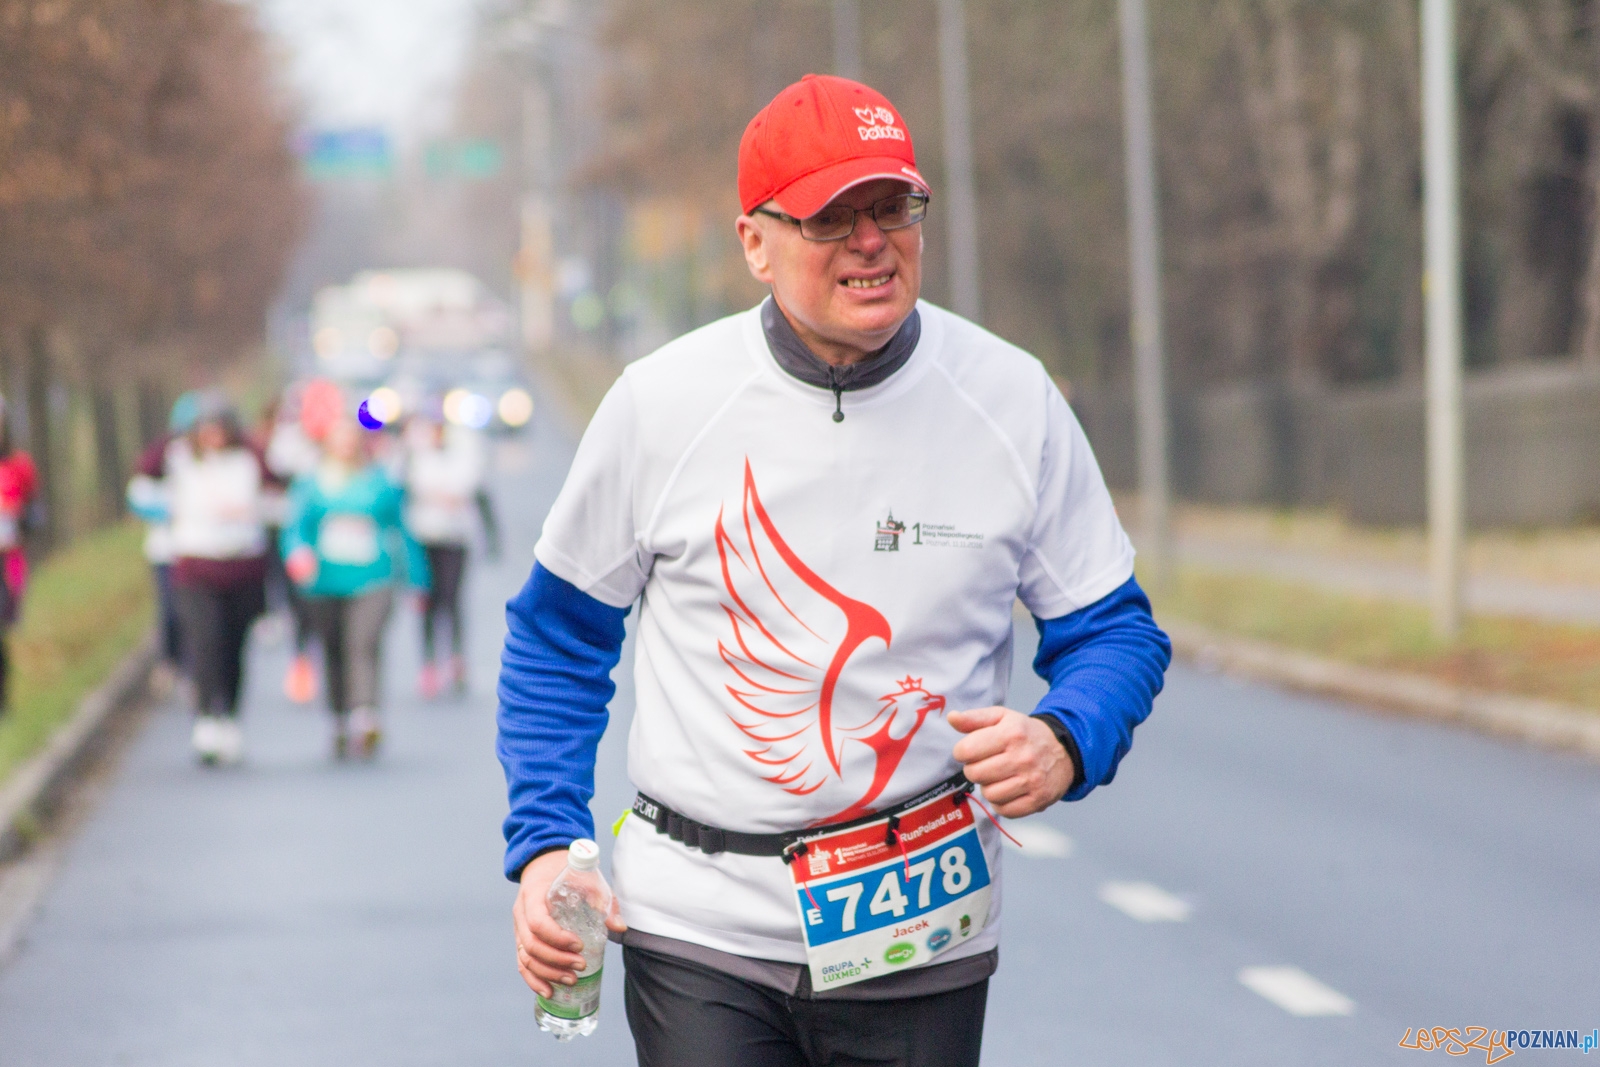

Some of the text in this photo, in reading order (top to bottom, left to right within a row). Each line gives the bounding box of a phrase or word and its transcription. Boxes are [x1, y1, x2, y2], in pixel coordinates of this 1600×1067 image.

[912, 522, 923, 545] 1
[900, 809, 963, 842] RunPoland.org
[806, 846, 972, 932] E 7478
[892, 919, 930, 938] Jacek
[822, 960, 854, 975] GRUPA
[823, 967, 861, 983] LUXMED
